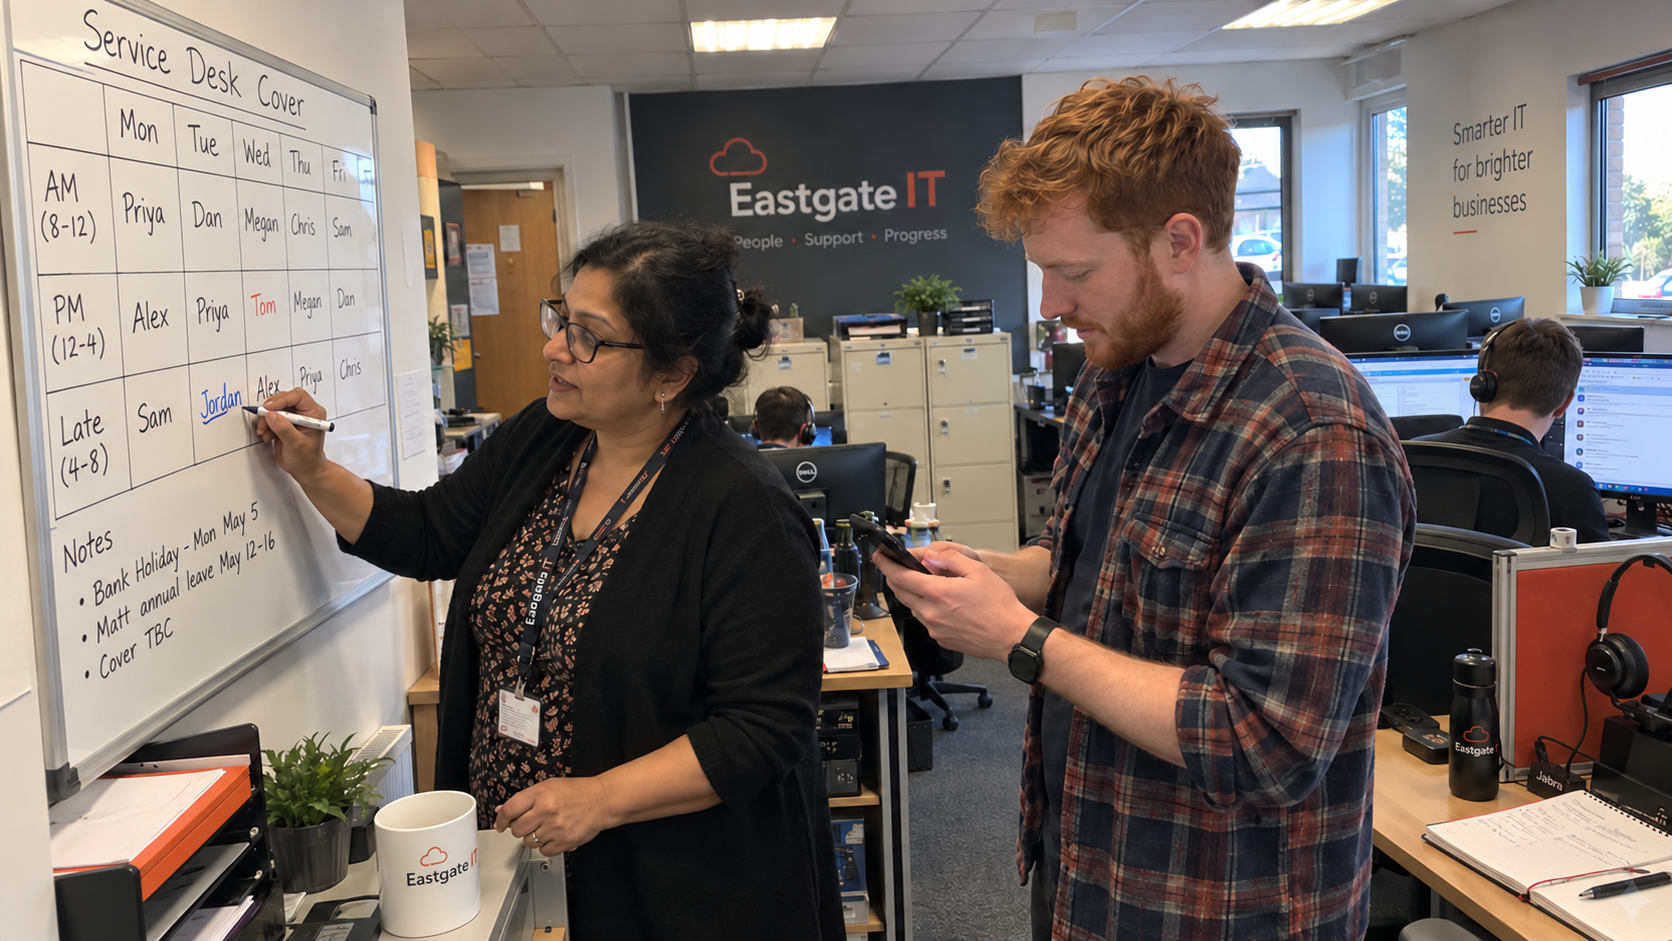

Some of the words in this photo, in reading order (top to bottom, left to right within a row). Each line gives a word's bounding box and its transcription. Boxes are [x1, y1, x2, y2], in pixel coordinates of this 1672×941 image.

[83, 9, 172, 74] Service
[186, 47, 243, 98] Desk
[257, 74, 306, 117] Cover
[120, 108, 159, 145] Mon
[187, 124, 219, 157] Tue
[242, 138, 271, 168] Wed
[288, 149, 312, 175] Thu
[332, 159, 347, 183] Fri
[1453, 114, 1509, 146] Smarter
[1513, 103, 1528, 131] IT
[1452, 158, 1472, 182] for
[1475, 148, 1534, 182] brighter
[44, 169, 79, 203] AM
[122, 191, 166, 237] Priya
[191, 200, 223, 229] Dan
[244, 207, 279, 243] Megan
[290, 212, 316, 236] Chris
[332, 216, 352, 238] Sam
[729, 180, 898, 223] Eastgate
[906, 169, 946, 208] IT
[1453, 192, 1527, 219] businesses
[40, 210, 96, 245] (8-12)
[804, 230, 864, 249] Support
[884, 228, 948, 245] Progress
[52, 293, 85, 325] PM
[132, 300, 169, 334] Alex
[195, 296, 230, 333] Priya
[250, 292, 277, 317] Tom
[293, 290, 323, 320] Megan
[336, 287, 356, 309] Dan
[51, 326, 105, 366] (12-4)
[60, 409, 105, 447] Late
[137, 402, 173, 434] Sam
[200, 382, 242, 419] Jordan
[256, 374, 280, 402] Alex
[299, 366, 323, 395] Priya
[339, 359, 362, 380] Chris
[60, 442, 109, 489] (4-8)
[63, 530, 113, 574] Notes
[92, 567, 131, 606] Bank
[135, 545, 180, 583] Holiday
[193, 527, 217, 551] Mon
[223, 511, 246, 537] May
[250, 500, 259, 521] 5
[97, 604, 131, 644] Matt
[139, 575, 181, 617] annual
[186, 564, 215, 591] leave
[219, 550, 241, 575] May
[245, 530, 276, 561] 12-16
[99, 642, 138, 679] Cover
[144, 617, 174, 650] TBC
[1455, 741, 1494, 757] Eastgate
[1535, 770, 1563, 792] Jabra
[406, 861, 469, 887] Eastgate
